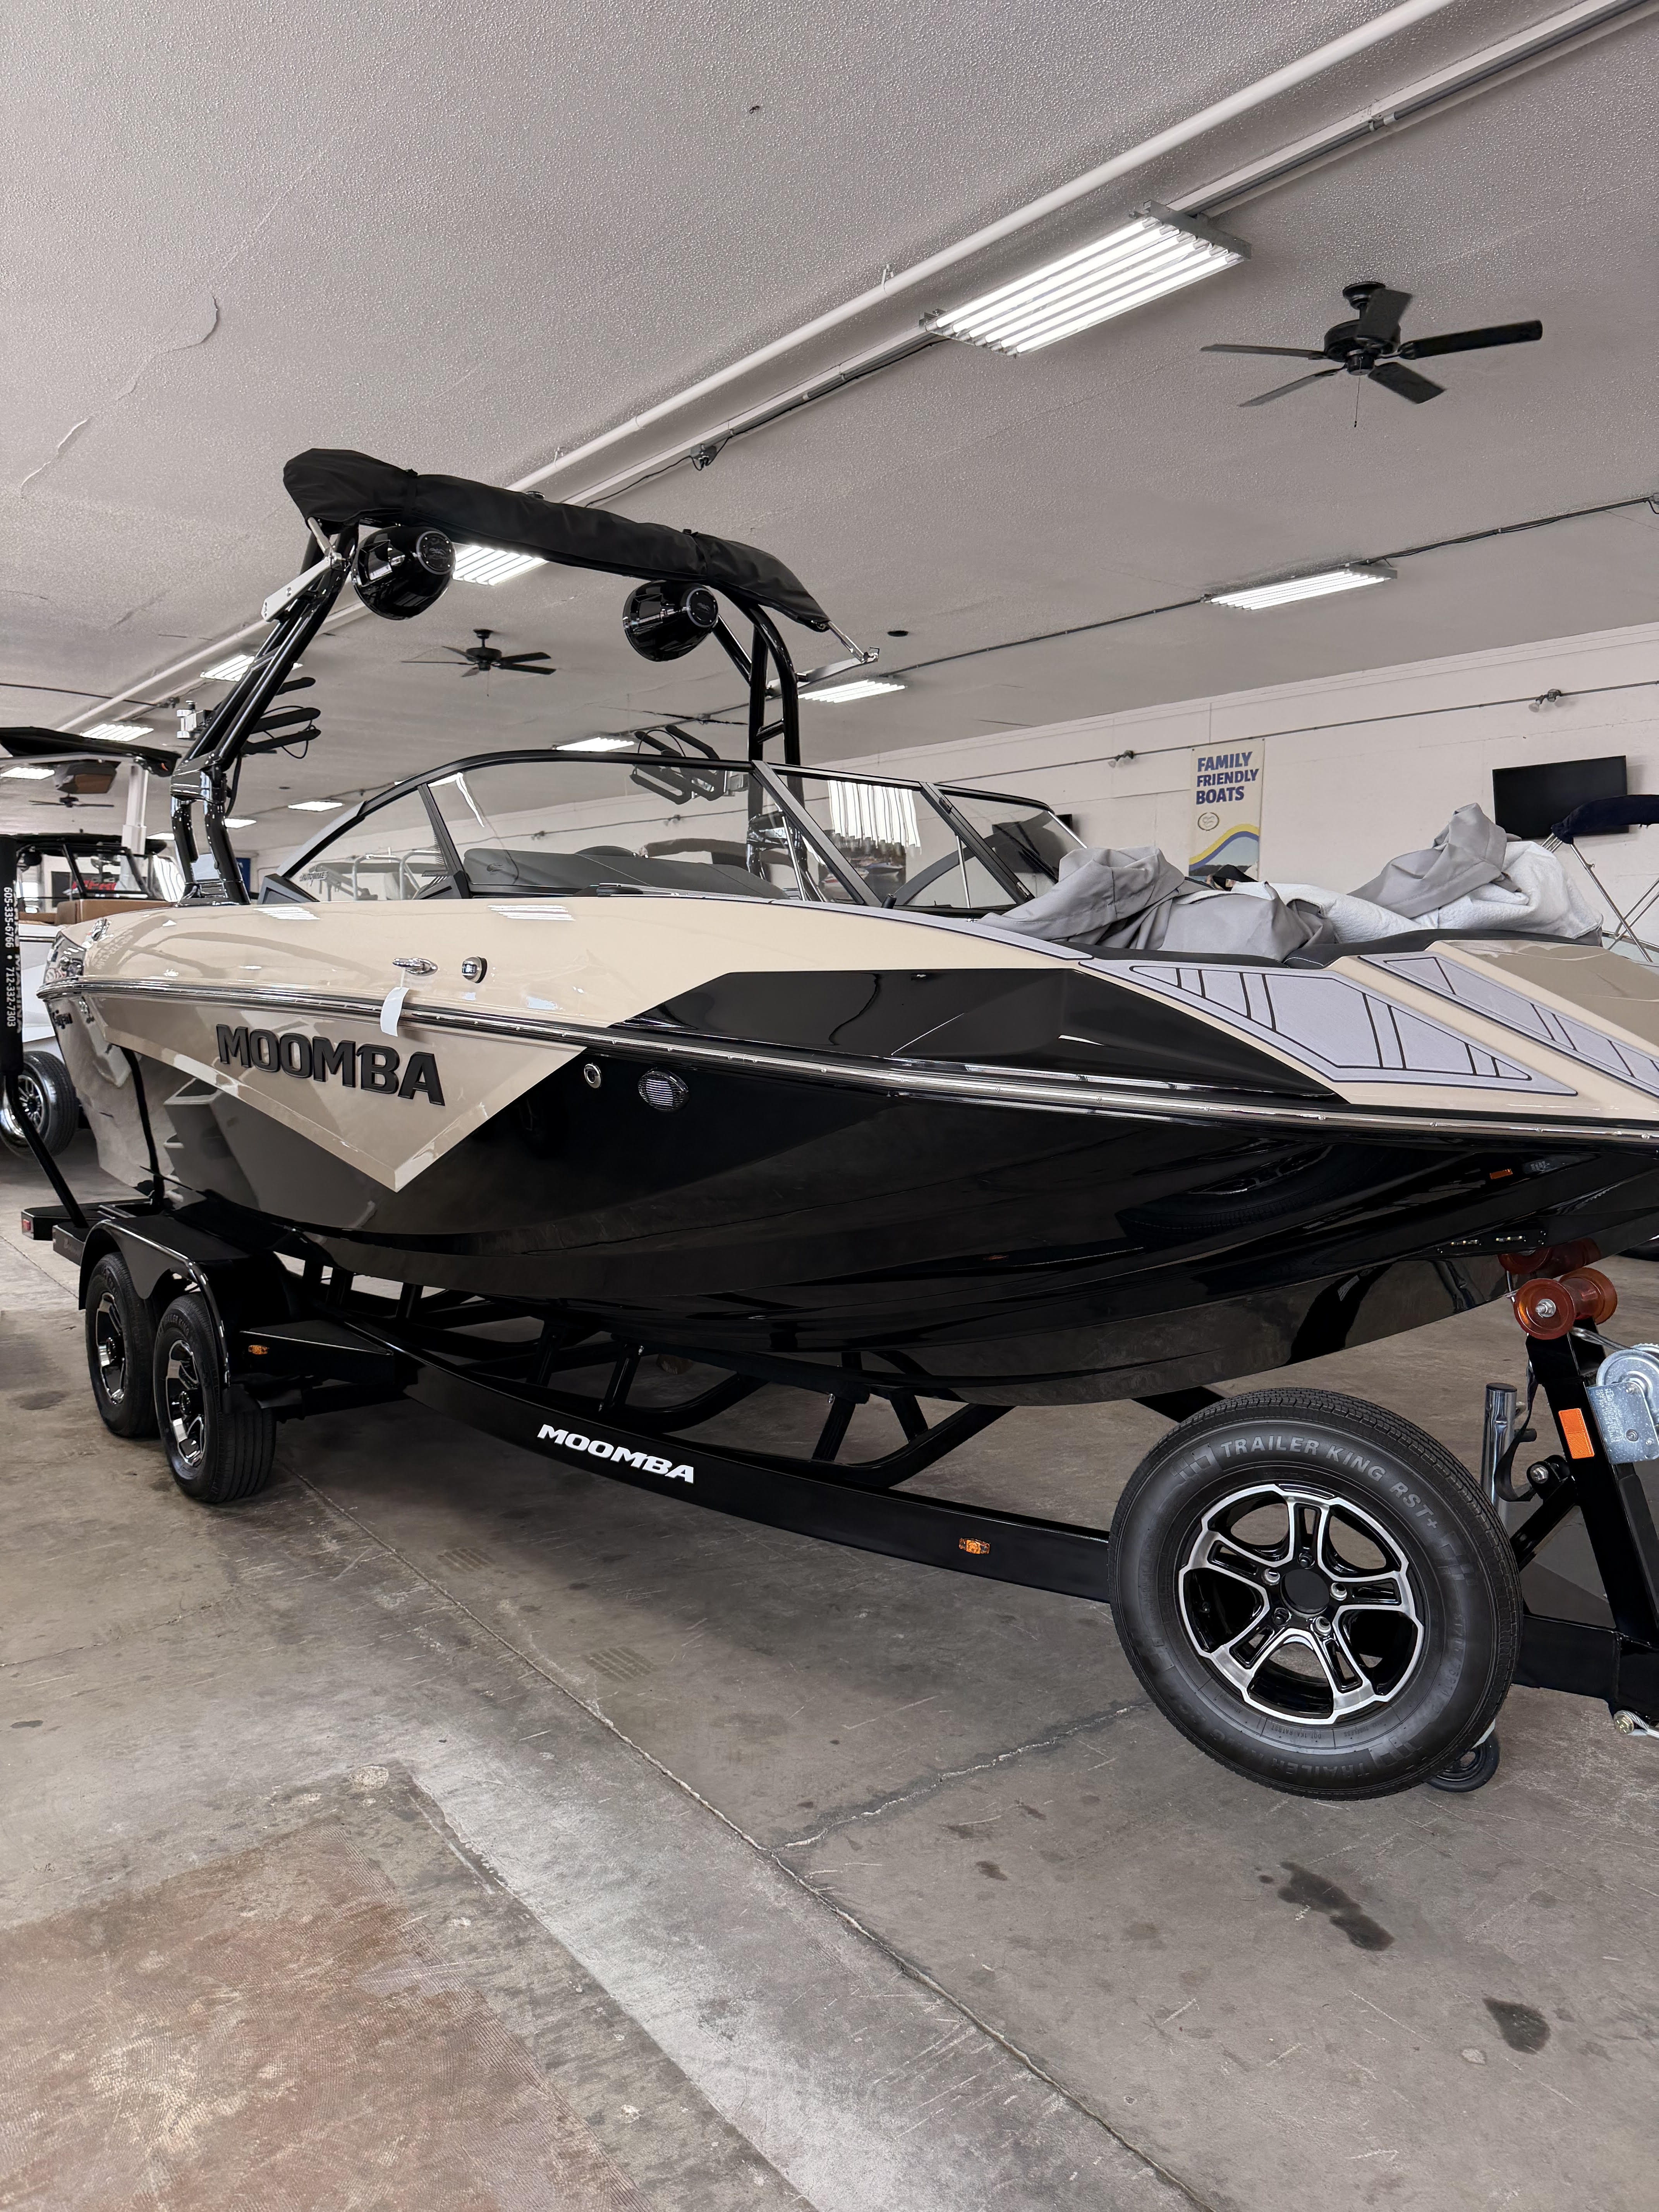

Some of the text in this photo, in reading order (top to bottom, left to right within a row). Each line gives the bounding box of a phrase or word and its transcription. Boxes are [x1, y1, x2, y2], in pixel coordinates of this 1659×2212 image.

[1197, 751, 1253, 772] FAMILY
[1197, 769, 1259, 787] FRIENDLY
[1196, 786, 1245, 805] BOATS
[6, 967, 16, 1027] 712-332-7303
[216, 1024, 445, 1106] MOOMBA
[537, 1424, 694, 1484] MOOMBA
[1221, 1435, 1438, 1529] TRAILER KING RST+
